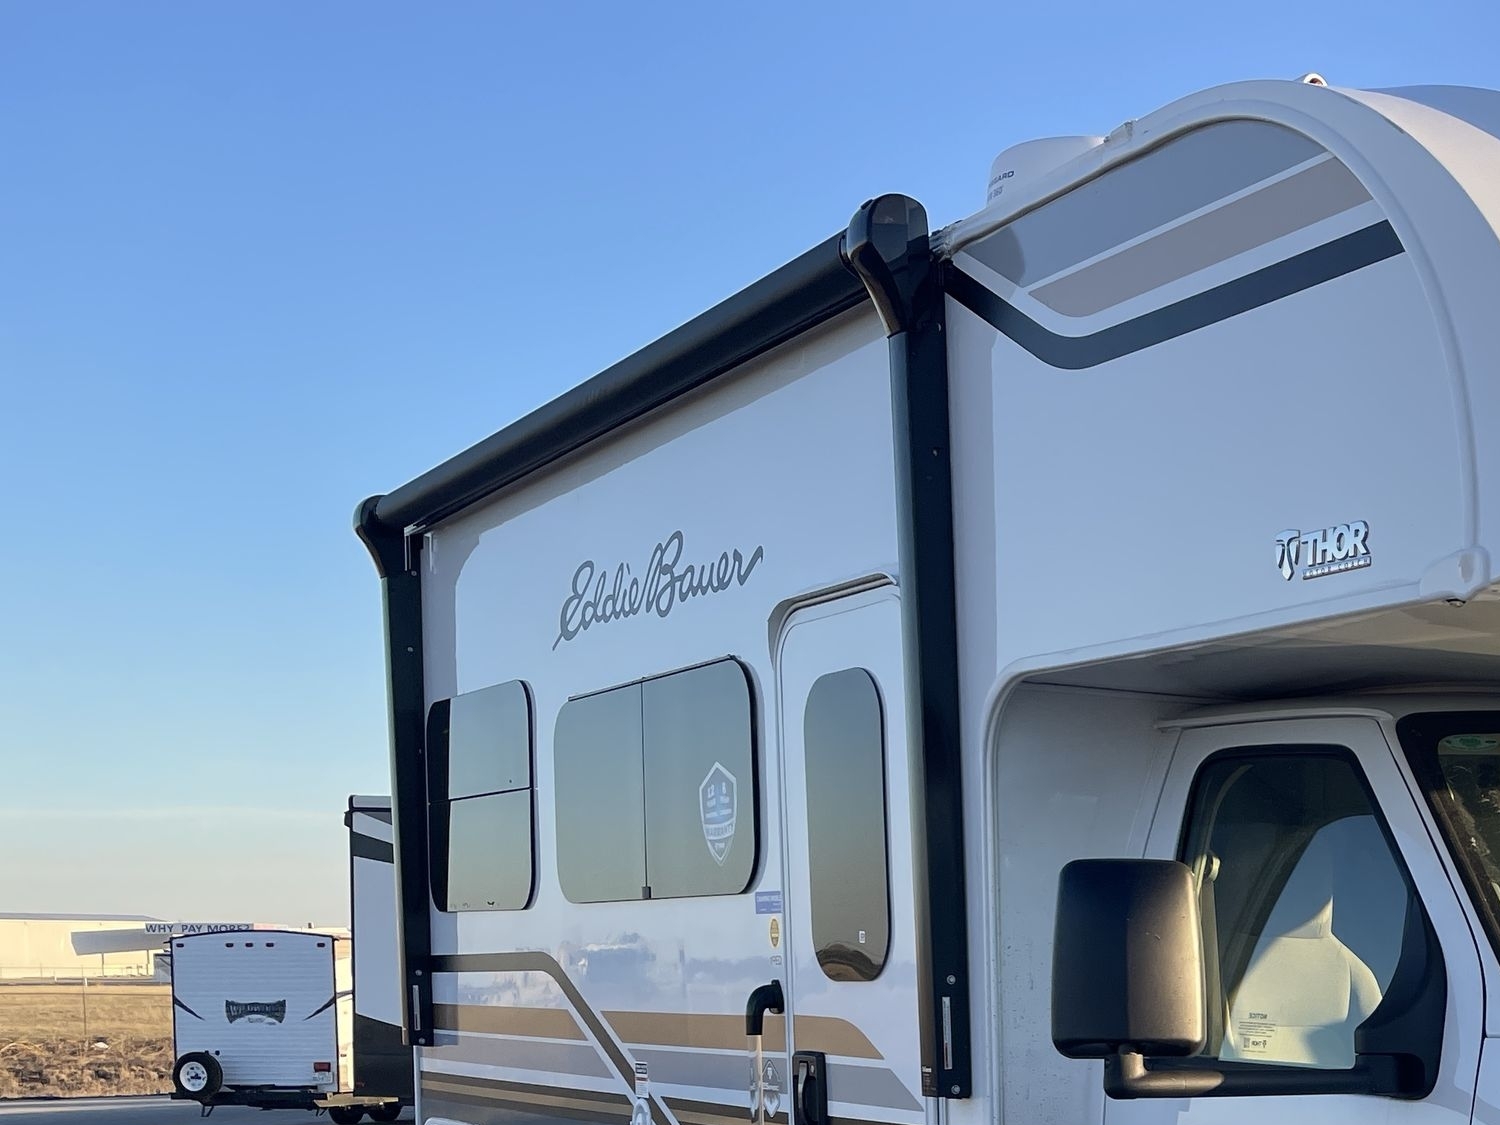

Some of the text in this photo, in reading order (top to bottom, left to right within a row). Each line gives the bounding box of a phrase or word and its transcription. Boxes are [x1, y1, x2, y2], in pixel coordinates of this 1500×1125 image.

[1301, 520, 1370, 567] THOR
[552, 530, 763, 651] Eddie Bauer
[145, 924, 174, 933] WHY
[182, 924, 202, 933] PAY
